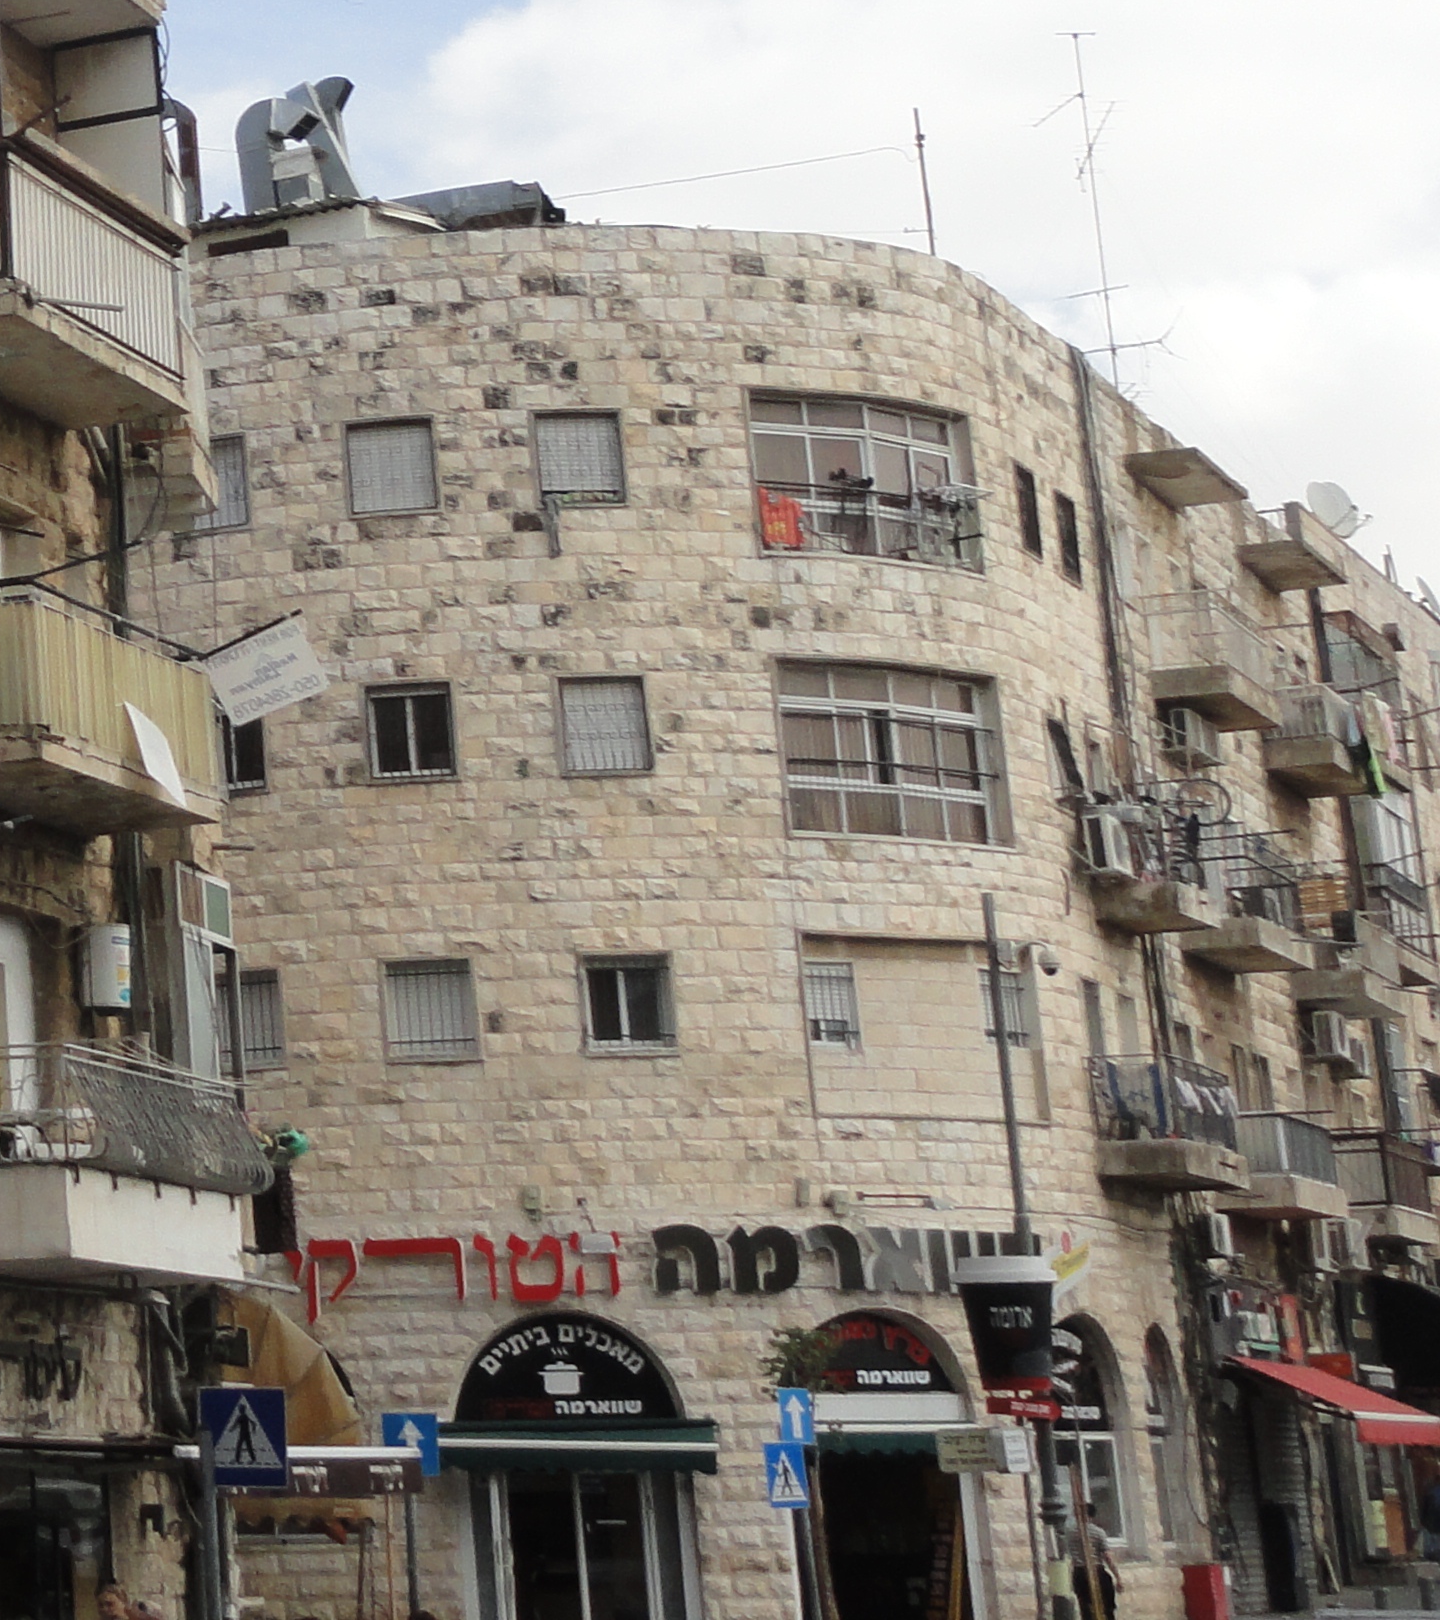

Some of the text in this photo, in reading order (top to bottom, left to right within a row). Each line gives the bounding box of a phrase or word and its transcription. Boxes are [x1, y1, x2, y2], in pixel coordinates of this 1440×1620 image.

[478, 1323, 647, 1376] מאכלים ביתיים
[855, 1369, 931, 1385] שווארמה
[554, 1399, 643, 1415] שווארמה
